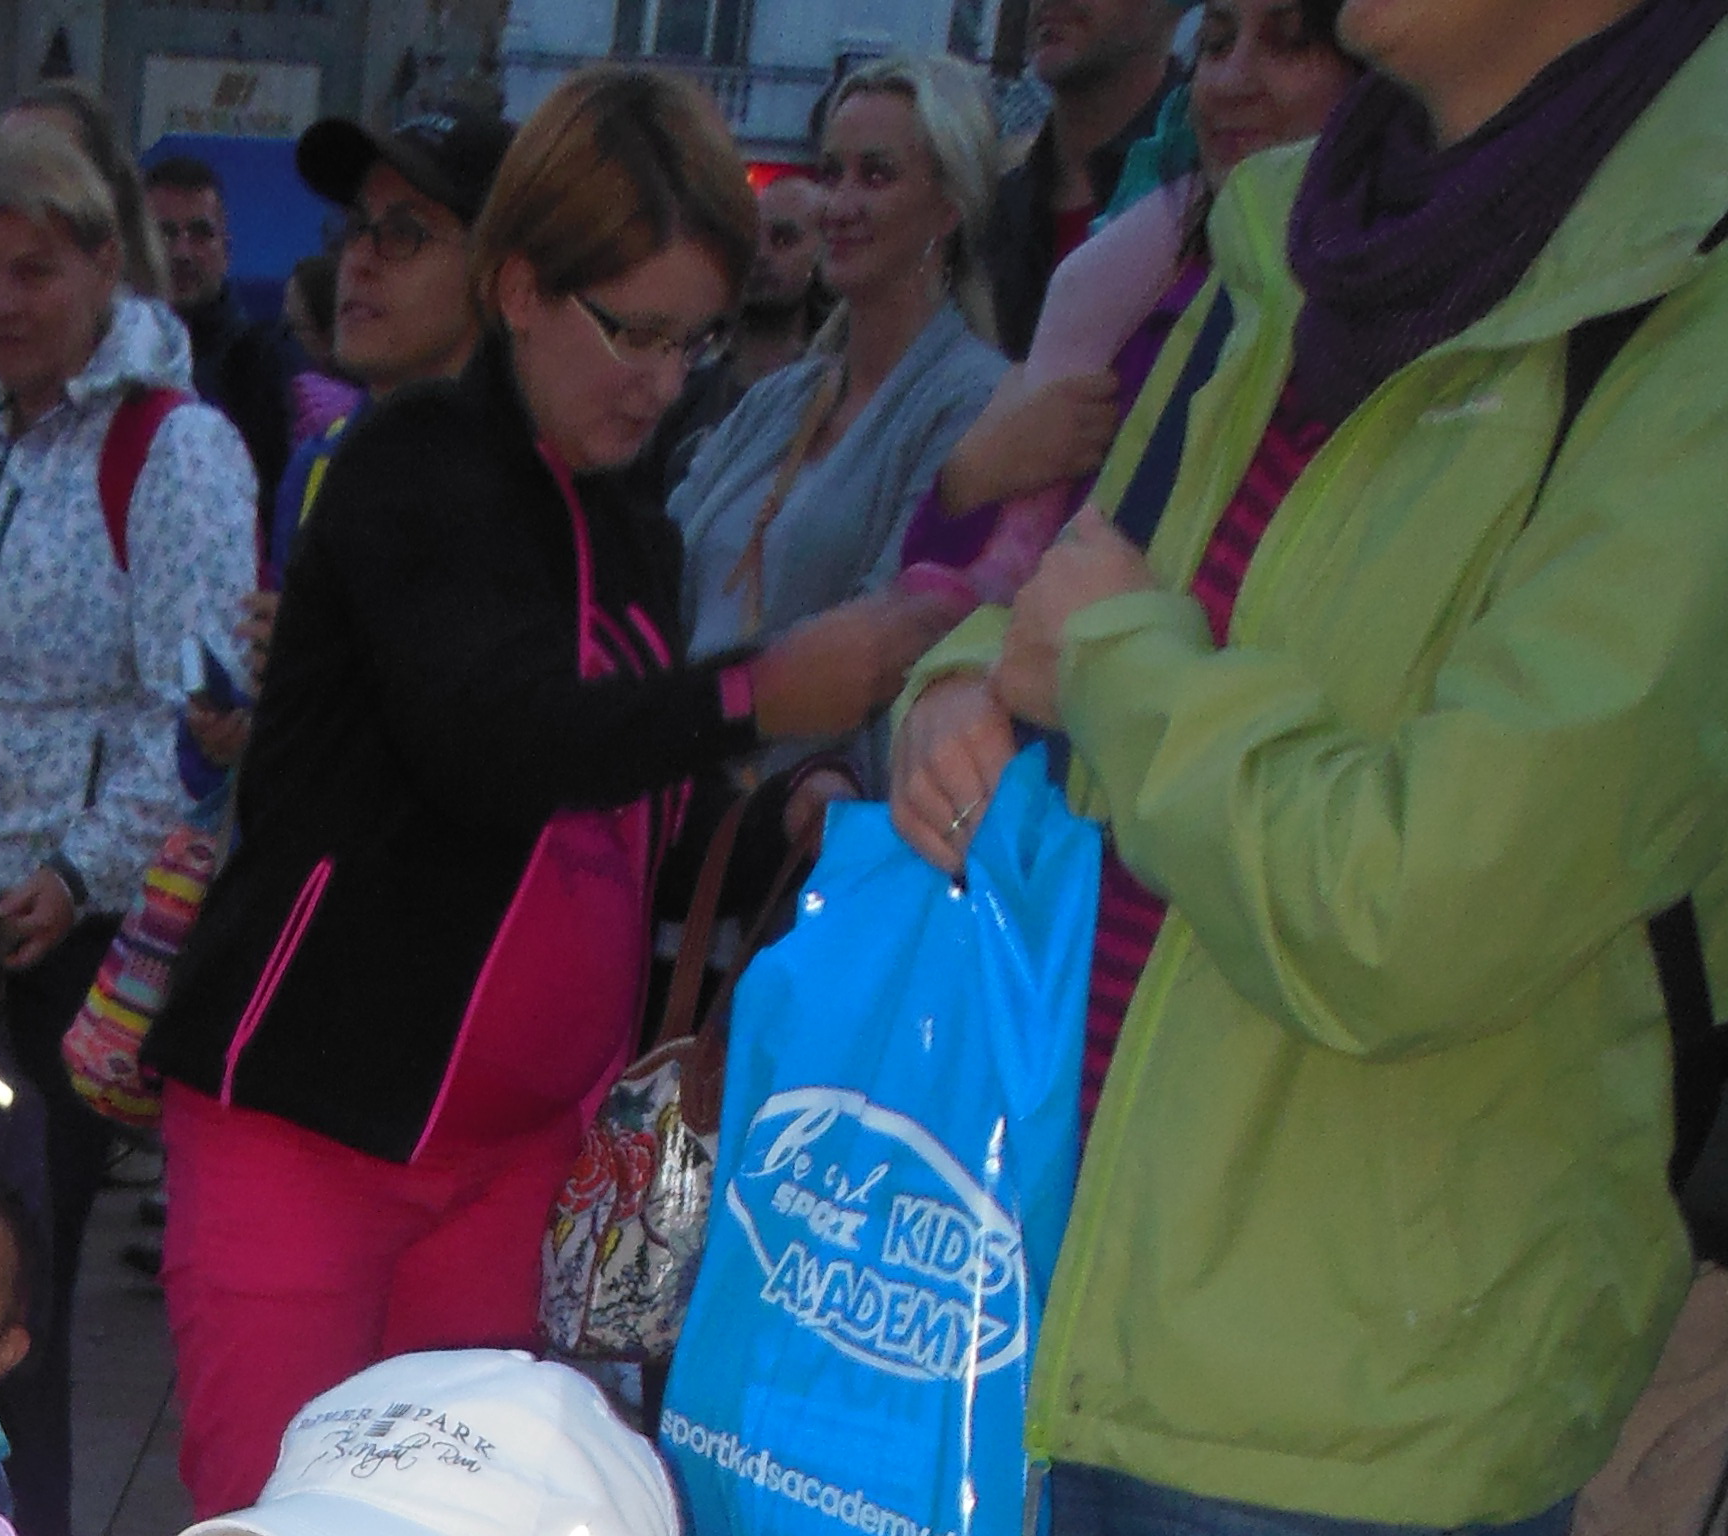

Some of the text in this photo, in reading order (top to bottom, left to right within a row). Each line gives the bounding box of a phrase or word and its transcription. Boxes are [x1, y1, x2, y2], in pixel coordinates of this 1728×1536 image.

[881, 1194, 1016, 1295] KIDS
[411, 1407, 497, 1461] PARK
[432, 1441, 483, 1474] Run
